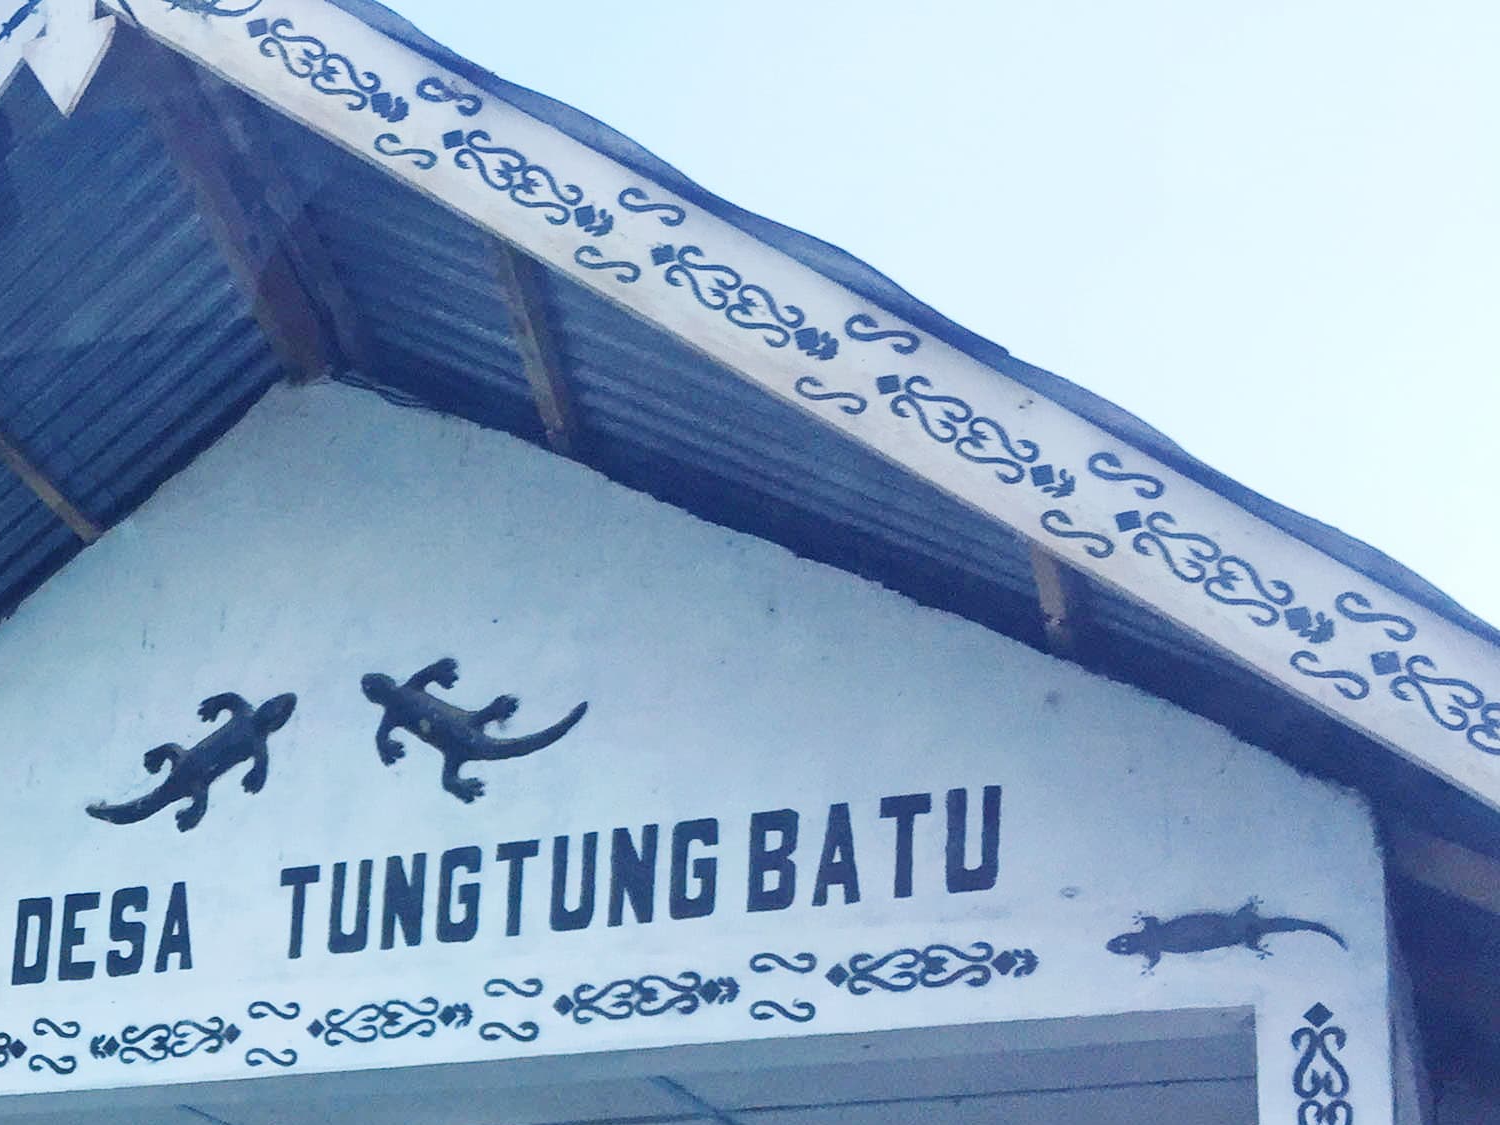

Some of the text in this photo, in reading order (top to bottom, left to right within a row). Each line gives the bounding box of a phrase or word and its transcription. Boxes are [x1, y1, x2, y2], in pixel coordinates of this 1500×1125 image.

[11, 881, 193, 985] DESA
[280, 817, 719, 959] TUNGTUNG
[746, 785, 1002, 912] BATU
